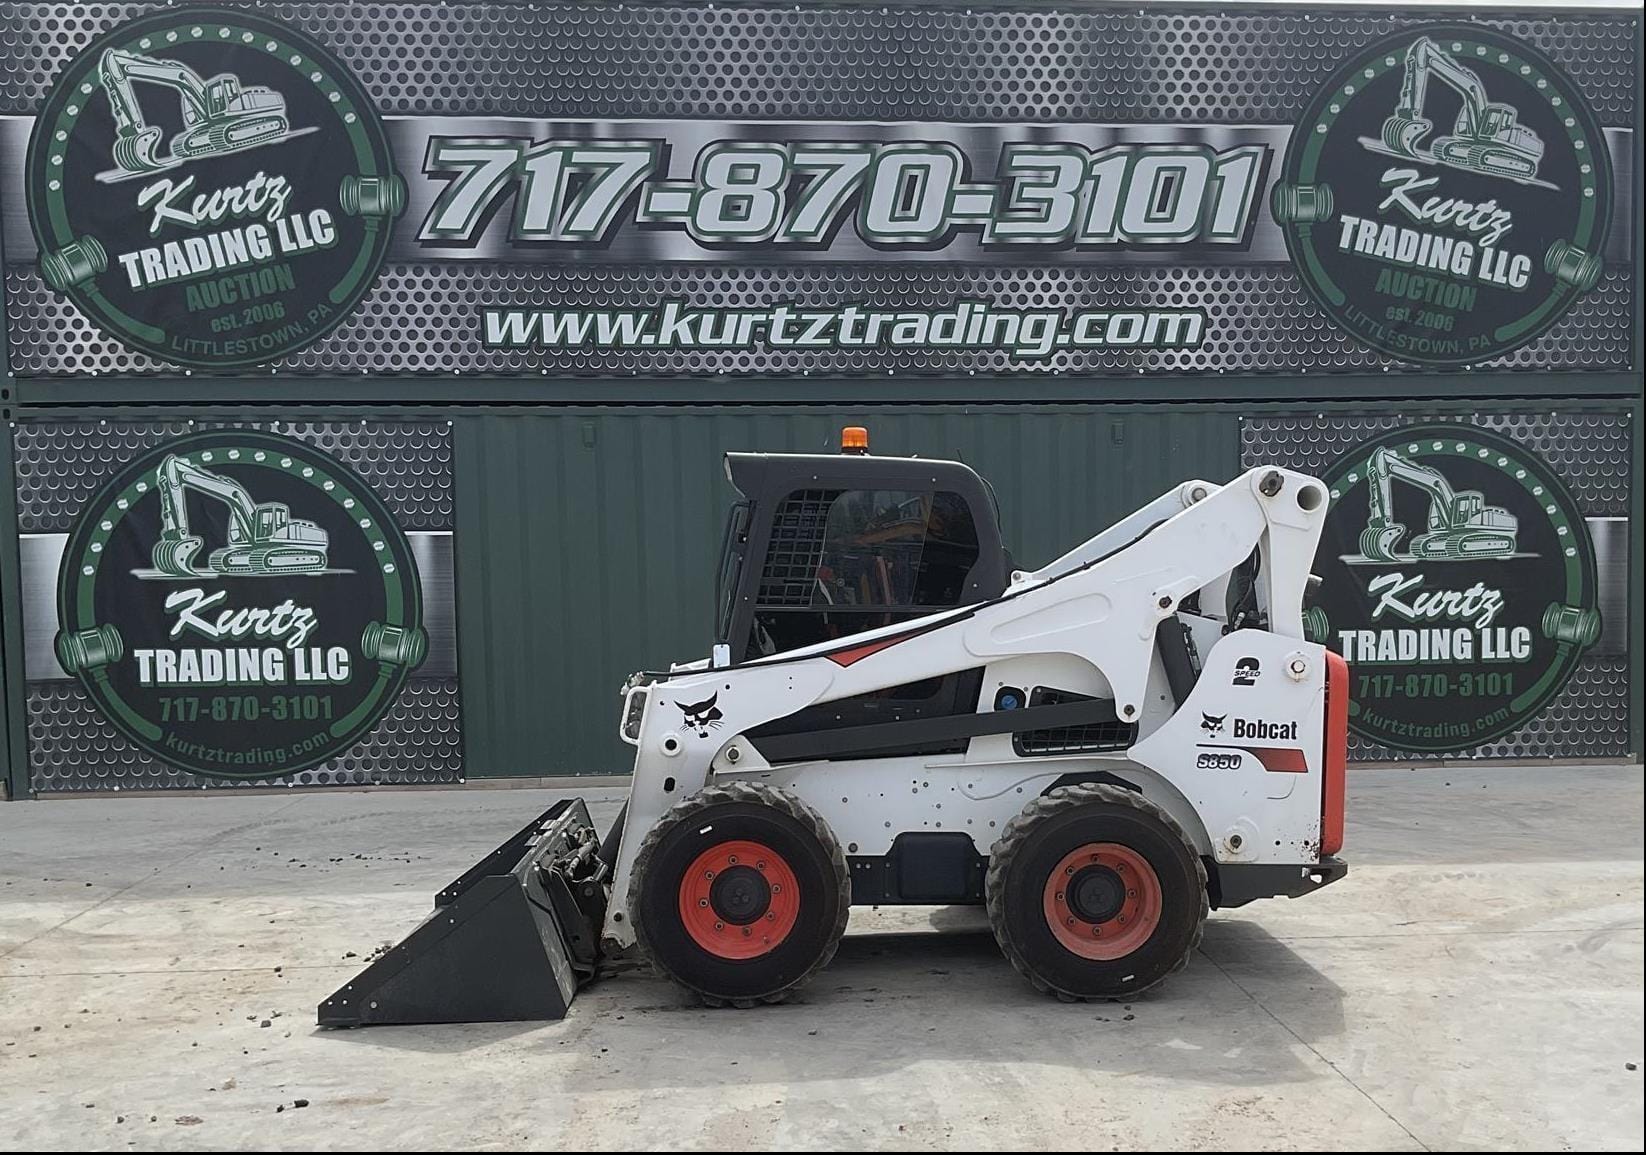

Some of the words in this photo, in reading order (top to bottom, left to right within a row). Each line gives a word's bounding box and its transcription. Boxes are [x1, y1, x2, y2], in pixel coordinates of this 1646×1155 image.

[137, 171, 292, 234] Kurtz
[418, 137, 1266, 246] 717-870-3101
[1378, 167, 1513, 248] Kurtz
[118, 224, 273, 289] TRADING
[277, 208, 336, 254] LLC
[1338, 214, 1474, 276] TRADING
[1477, 246, 1532, 289] LLC
[186, 263, 296, 312] AUCTION
[1375, 268, 1478, 312] AUCTION
[171, 321, 309, 355] LITTLESTOWN,
[307, 302, 332, 324] PA
[482, 300, 1206, 357] www.kurtztrading.com
[1344, 304, 1464, 355] LITTLESTOWN,
[1468, 334, 1491, 350] PA
[164, 588, 319, 650] Kurtz
[1367, 572, 1506, 630] Kurtz
[134, 646, 286, 684] TRADING
[294, 646, 351, 683] LLC
[1338, 628, 1473, 663] TRADING
[1480, 626, 1531, 660] LLC
[1232, 656, 1260, 686] 2
[1233, 669, 1261, 677] SPEED
[1358, 672, 1514, 698] 717-870-3101
[159, 695, 334, 722] 717-870-3101
[1233, 718, 1298, 740] Bobcat
[1362, 706, 1510, 738] kurtztrading.com
[165, 731, 330, 766] kurtztrading.com
[1196, 753, 1243, 770] S850
